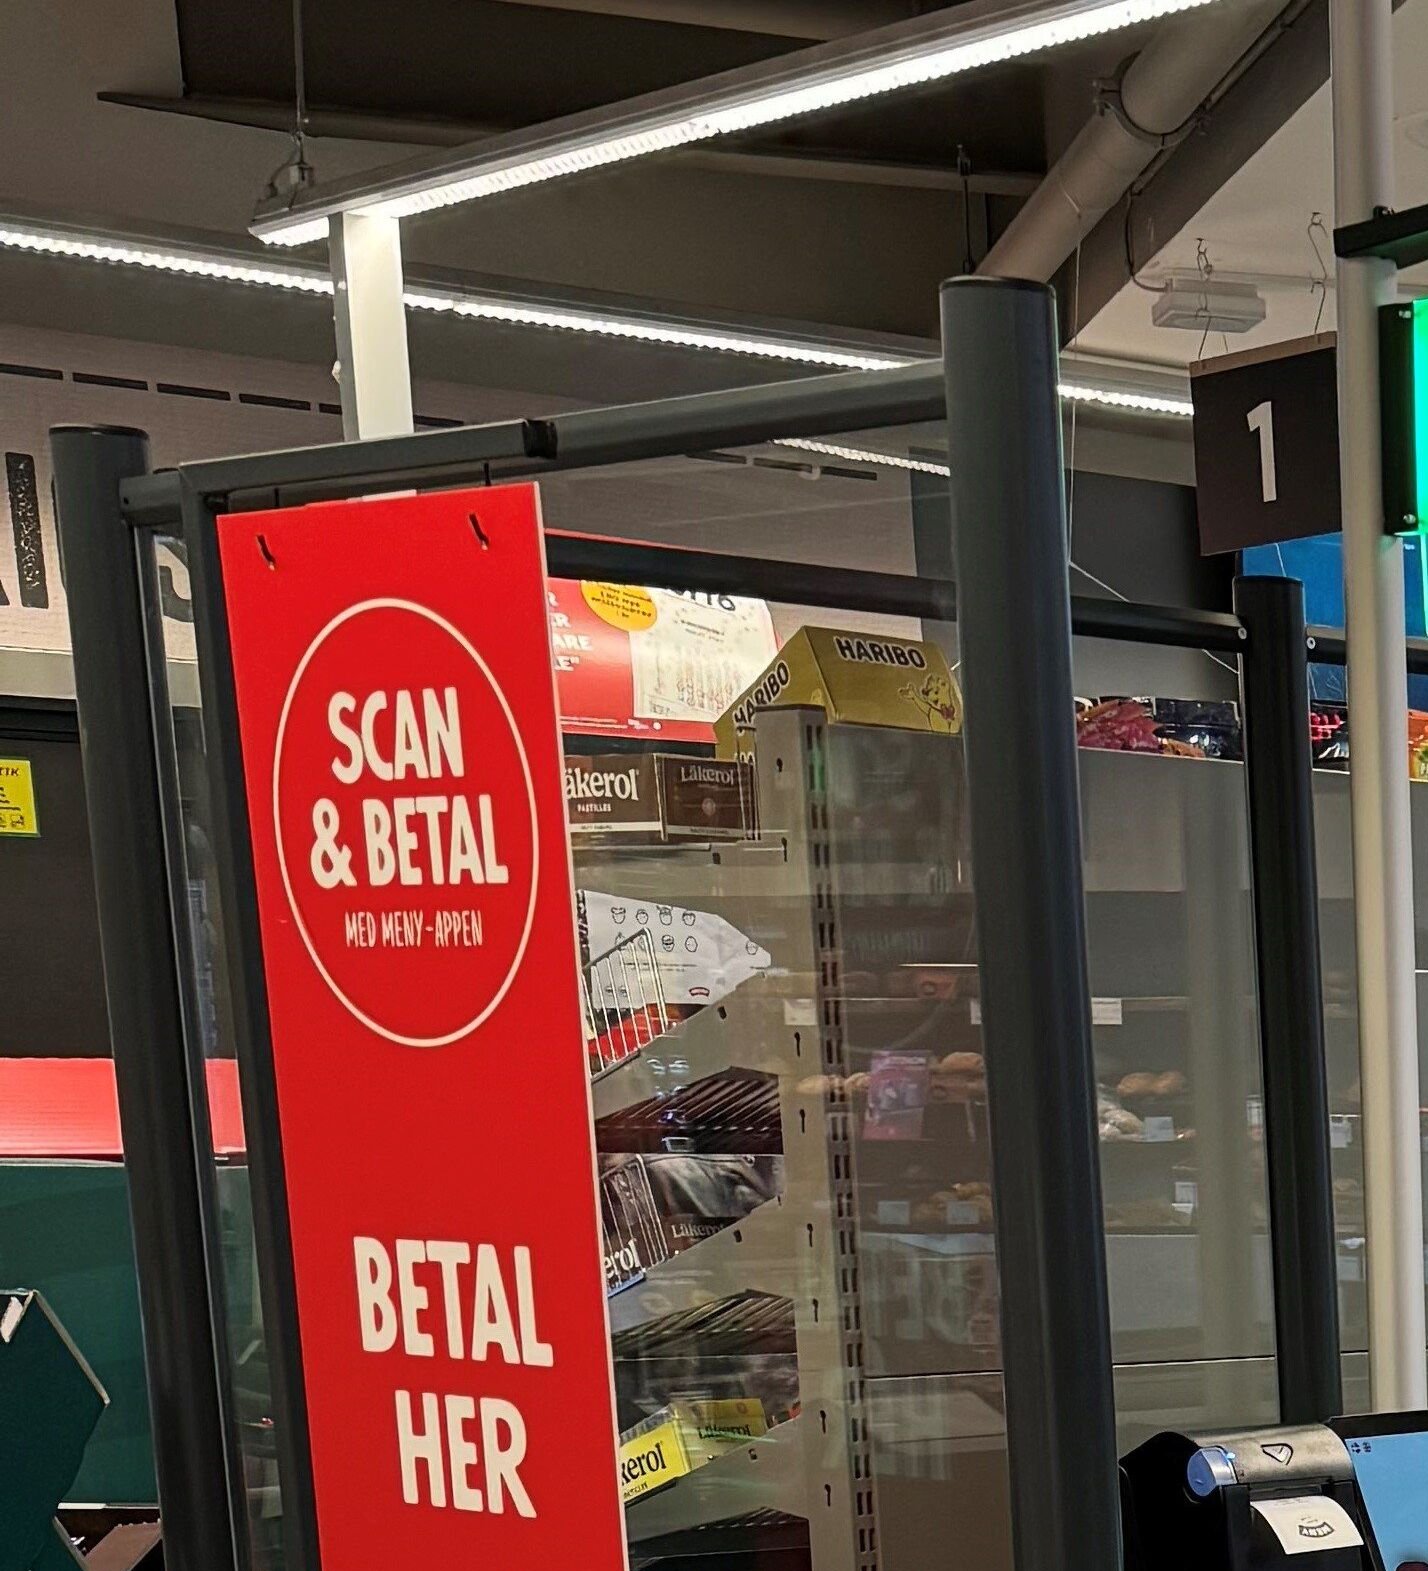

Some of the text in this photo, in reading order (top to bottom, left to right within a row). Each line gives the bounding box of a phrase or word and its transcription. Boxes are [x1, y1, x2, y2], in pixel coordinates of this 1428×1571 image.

[1245, 401, 1276, 502] 1
[834, 636, 926, 670] HARIBO
[327, 686, 465, 784] SCAN
[733, 661, 790, 736] HARIBO
[564, 767, 640, 801] äkerol
[680, 765, 735, 783] Läkerol
[311, 794, 509, 889] & BETAL
[345, 909, 484, 948] MED MENY-APPEN
[353, 1236, 554, 1367] BETAL
[395, 1389, 538, 1519] HER
